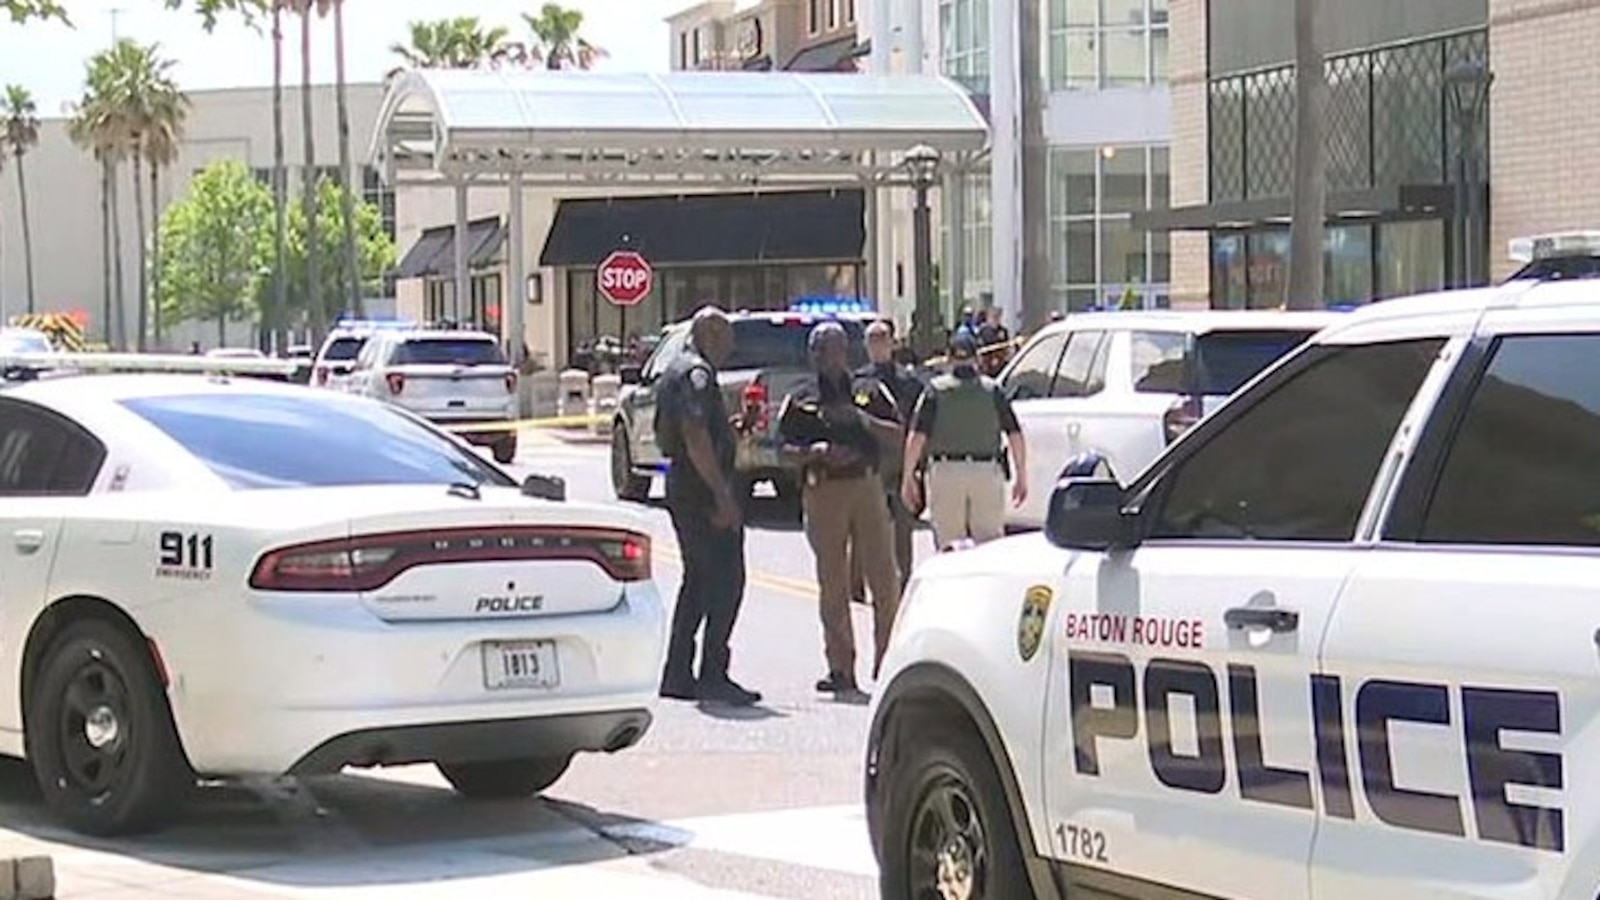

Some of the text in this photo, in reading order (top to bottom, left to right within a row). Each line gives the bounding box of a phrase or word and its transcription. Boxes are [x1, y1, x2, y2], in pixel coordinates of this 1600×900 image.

[603, 267, 646, 289] STOP
[161, 531, 212, 568] 911
[475, 595, 544, 612] POLICE
[1065, 613, 1203, 648] BATON ROUGE
[503, 653, 540, 676] 1813
[1068, 652, 1564, 853] POLICE
[1056, 823, 1108, 862] 1782
